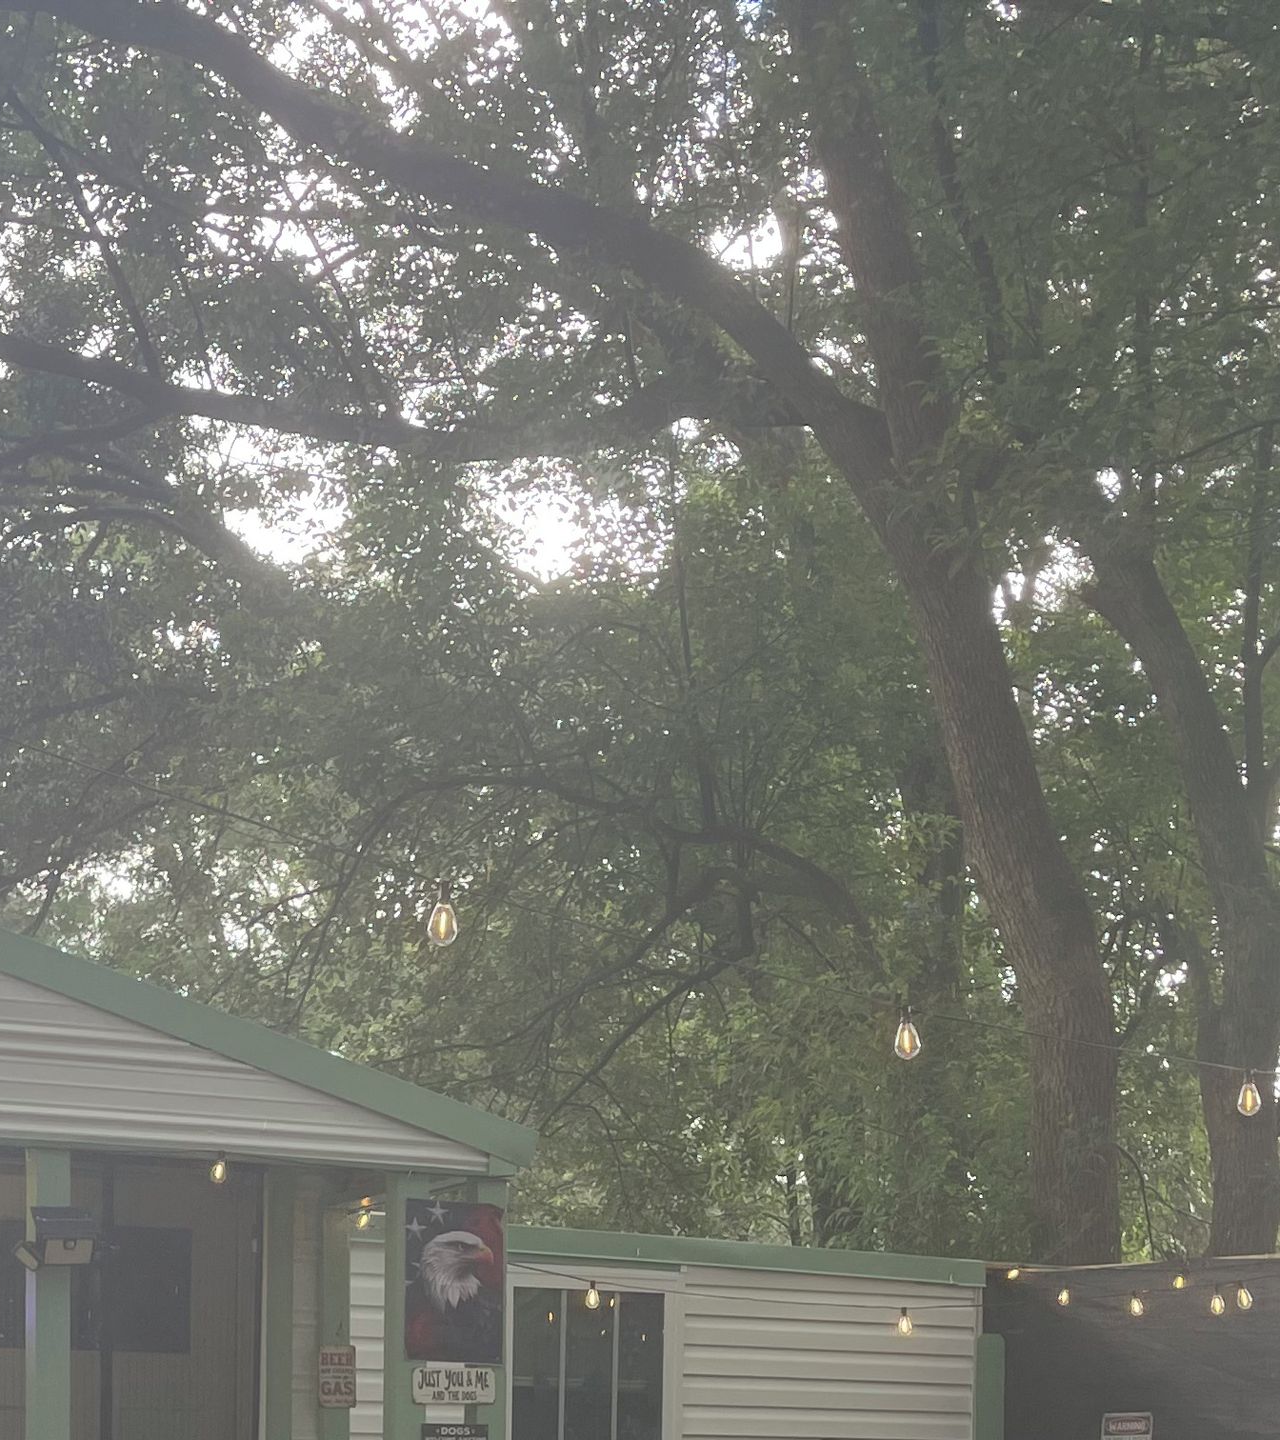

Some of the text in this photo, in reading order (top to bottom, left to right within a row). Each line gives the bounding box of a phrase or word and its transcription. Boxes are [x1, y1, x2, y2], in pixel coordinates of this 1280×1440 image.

[321, 1352, 353, 1366] BEER
[418, 1369, 489, 1391] JUST YOU & ME
[321, 1381, 353, 1396] GAS
[432, 1391, 477, 1400] AND THE DOGS
[440, 1426, 470, 1436] DOGS
[1108, 1420, 1146, 1431] WARNING
